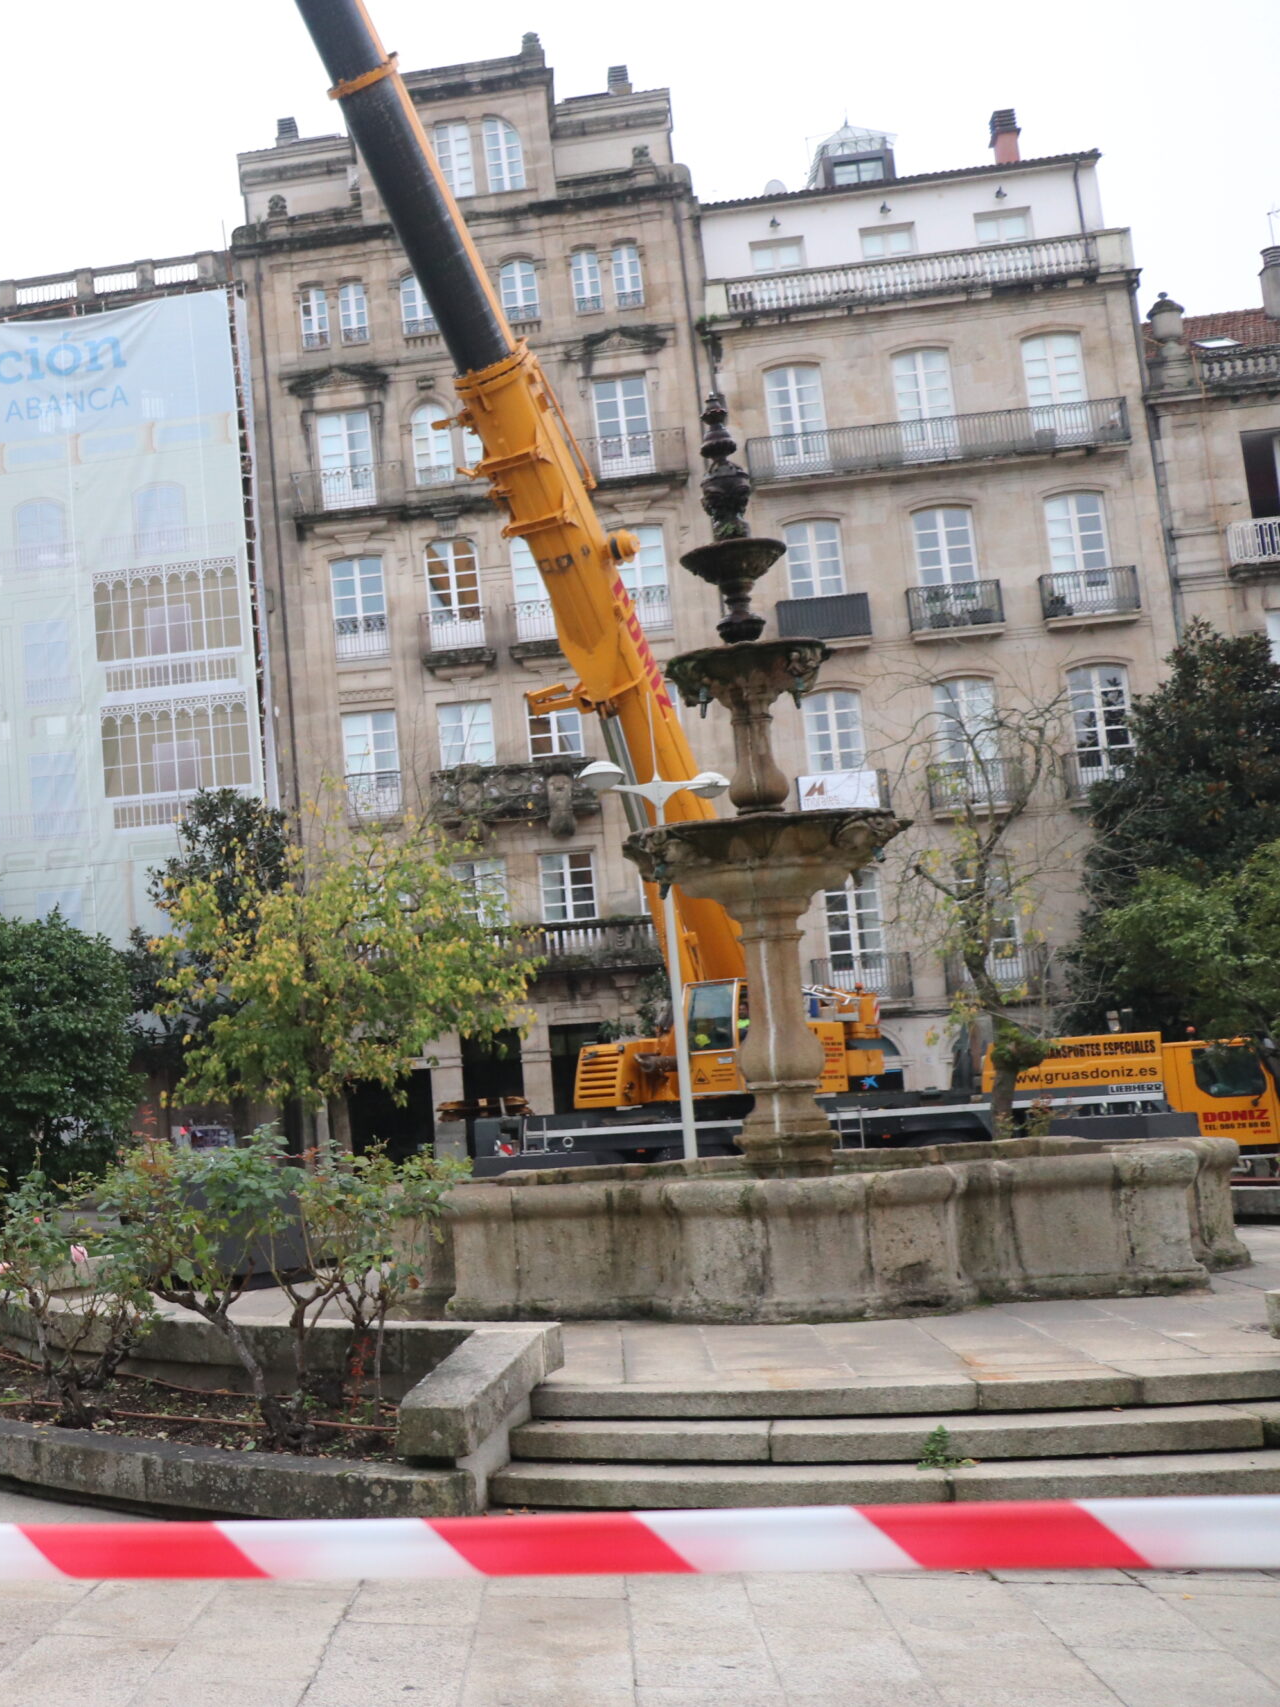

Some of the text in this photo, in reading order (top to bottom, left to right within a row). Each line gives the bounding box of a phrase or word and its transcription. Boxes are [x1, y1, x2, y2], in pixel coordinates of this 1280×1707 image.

[5, 385, 129, 424] ABANCA
[1103, 1040, 1156, 1055] ESPECIALES
[1016, 1066, 1158, 1085] ww.gruasdoniz.es
[1110, 1083, 1162, 1093] LIEBHERR
[1203, 1109, 1269, 1123] DONIZ
